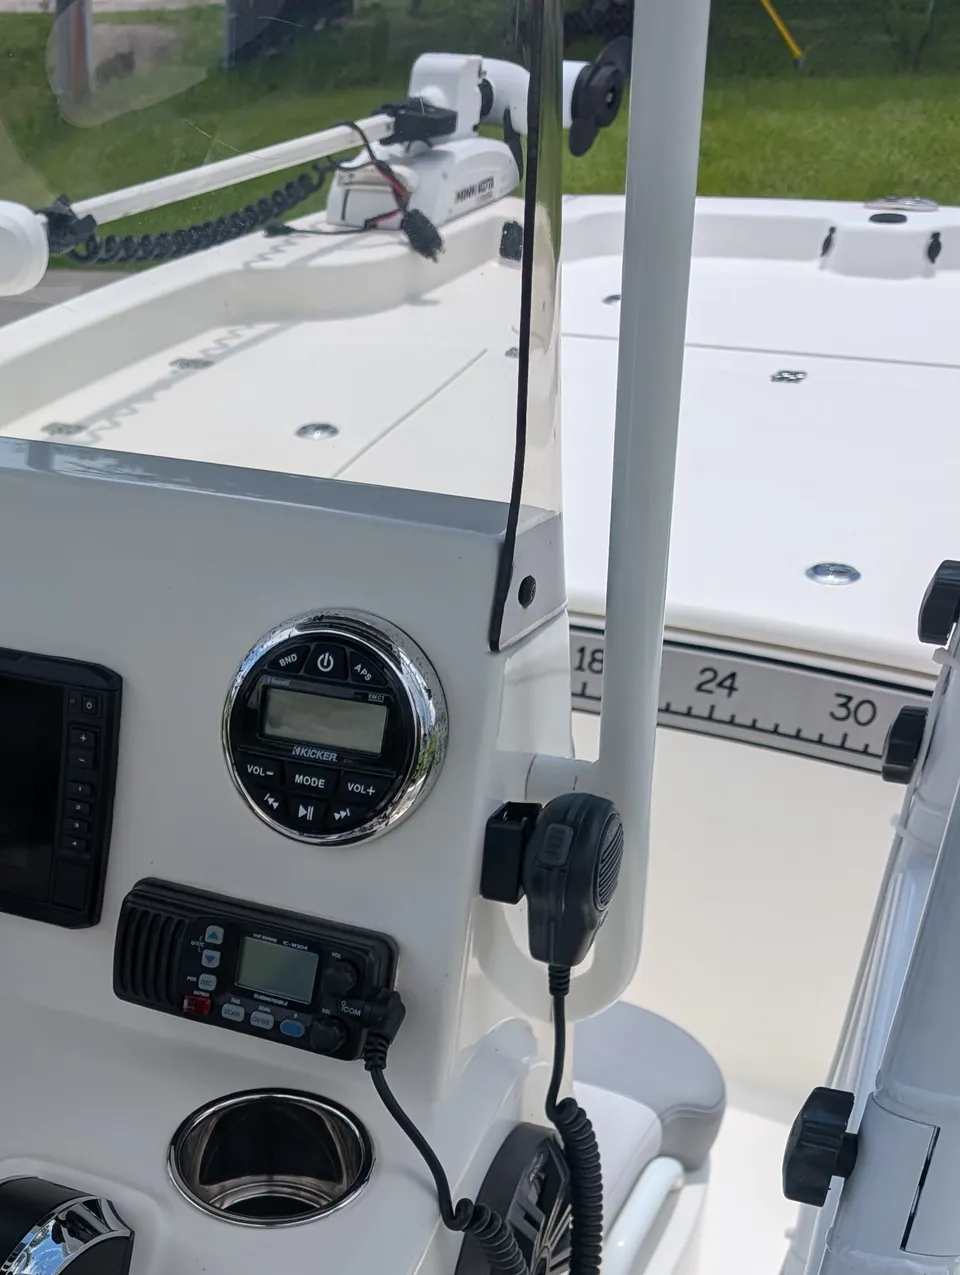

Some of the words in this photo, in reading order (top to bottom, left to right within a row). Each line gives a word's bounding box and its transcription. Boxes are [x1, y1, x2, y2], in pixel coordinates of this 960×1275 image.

[279, 653, 298, 667] BND
[573, 646, 604, 675] 18
[354, 663, 372, 682] APS
[695, 667, 738, 698] 24
[829, 693, 877, 727] 30
[299, 746, 338, 762] KICKER
[294, 774, 325, 789] MODE
